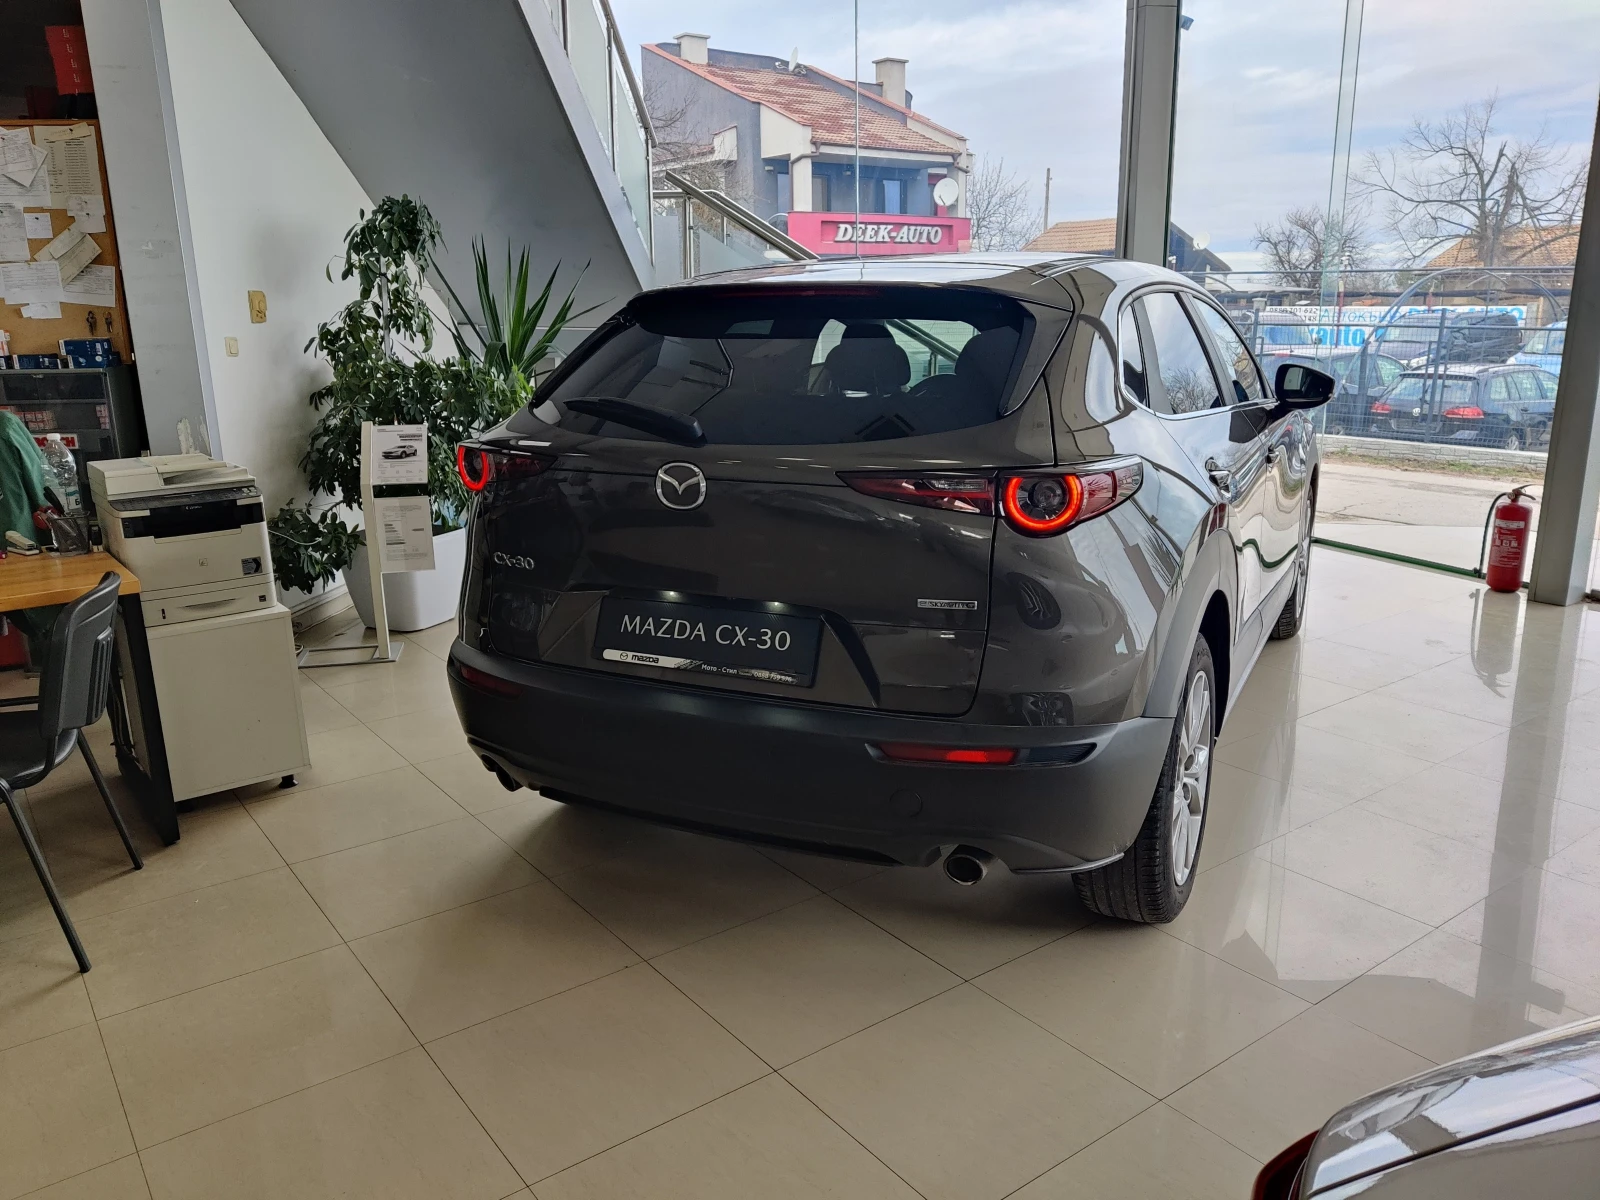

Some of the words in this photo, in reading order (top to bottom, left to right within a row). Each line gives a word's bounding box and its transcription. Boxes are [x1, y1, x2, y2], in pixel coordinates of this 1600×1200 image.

[835, 223, 942, 244] DEEK-AUTO
[493, 551, 535, 570] CX-30
[620, 614, 706, 642] MAZDA
[715, 624, 791, 652] CX-30
[631, 654, 659, 664] mazda
